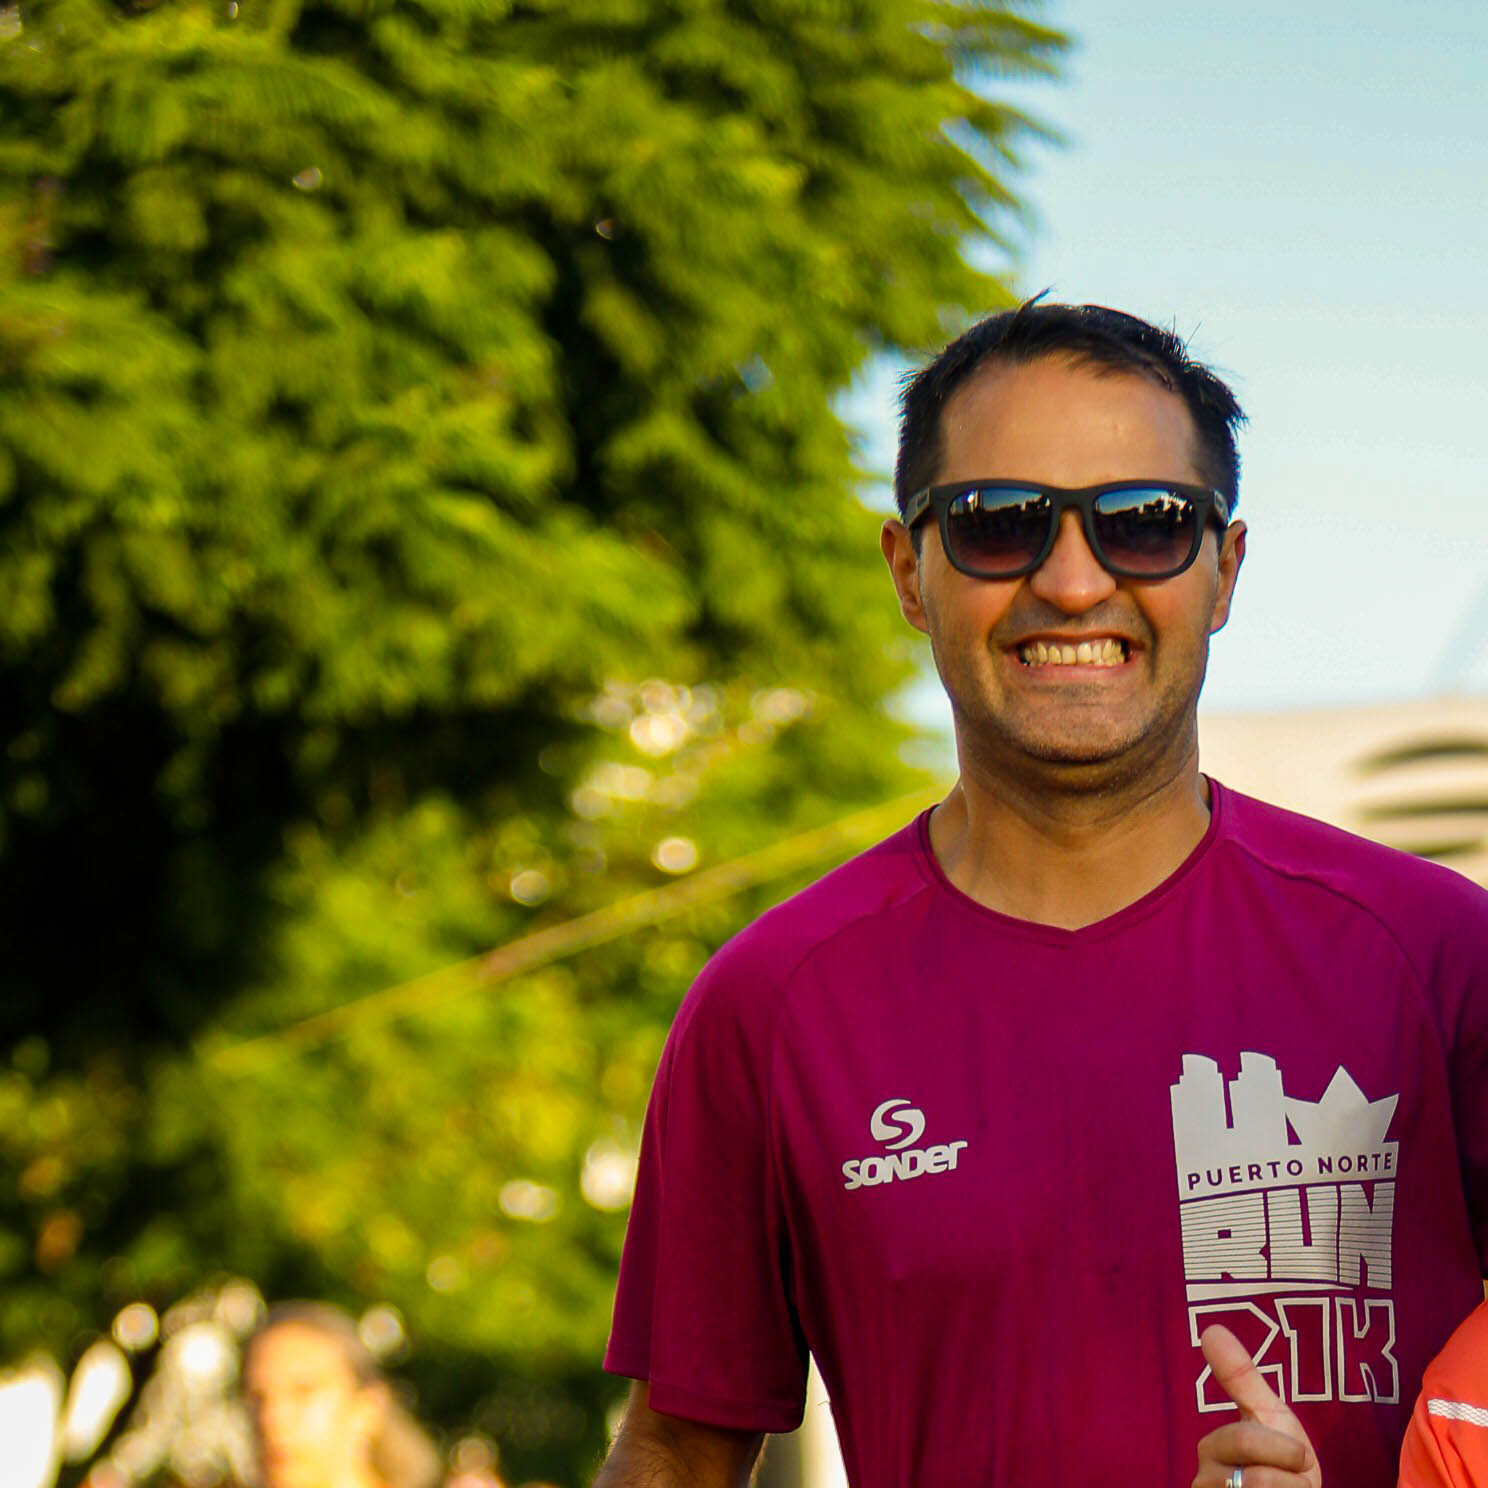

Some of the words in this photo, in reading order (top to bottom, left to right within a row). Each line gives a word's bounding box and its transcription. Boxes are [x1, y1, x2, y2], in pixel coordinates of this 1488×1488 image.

[1187, 1160, 1303, 1190] PUERTO
[1318, 1152, 1393, 1175] NORTE
[1180, 1182, 1395, 1290] RUN
[1188, 1297, 1400, 1412] 21K
